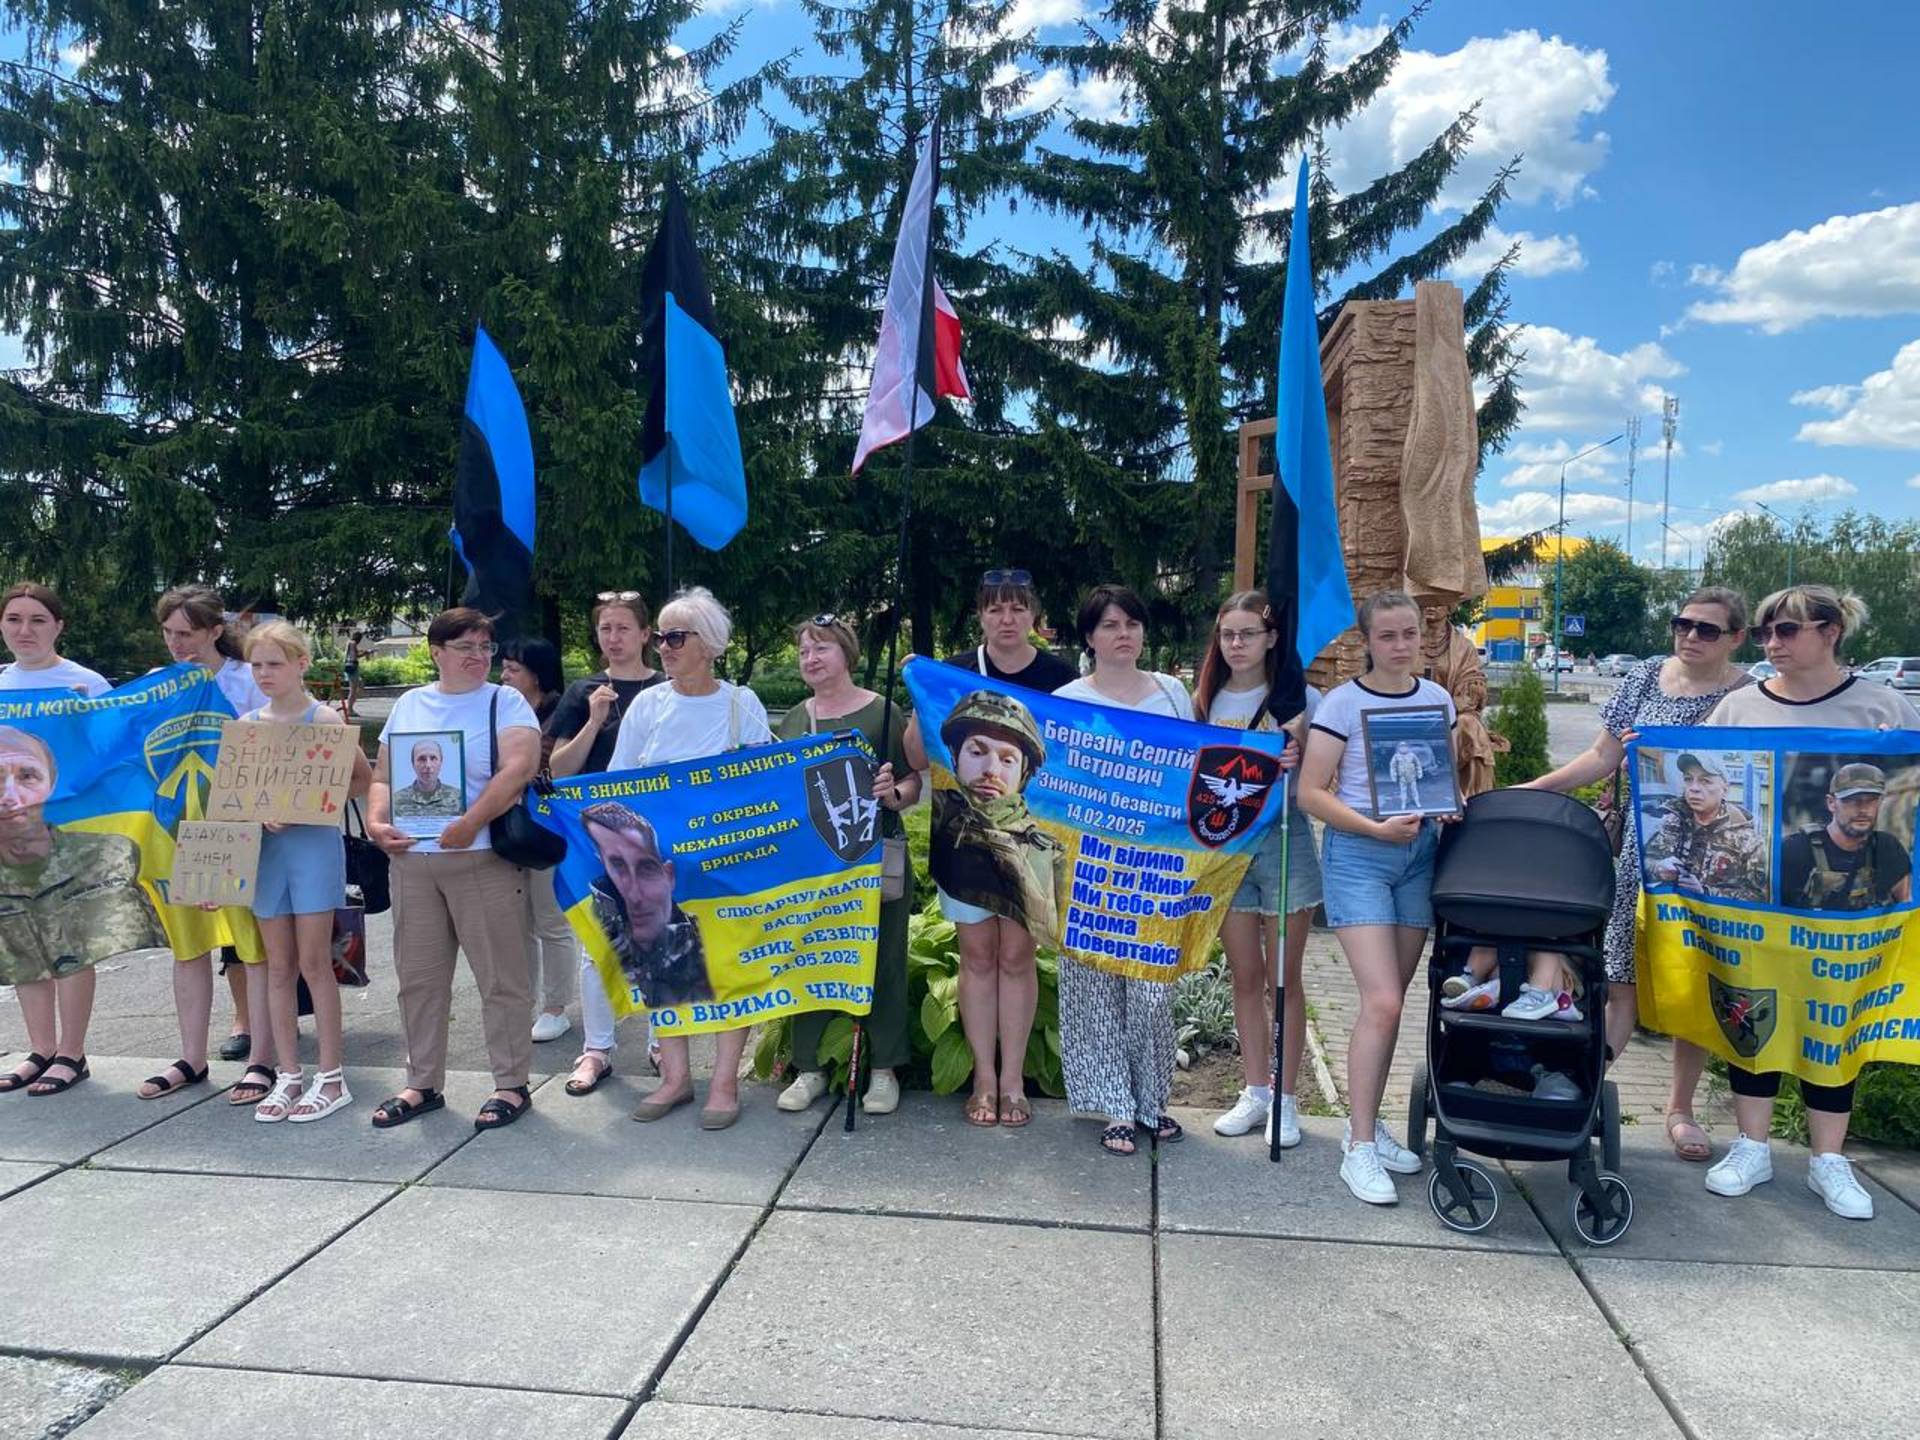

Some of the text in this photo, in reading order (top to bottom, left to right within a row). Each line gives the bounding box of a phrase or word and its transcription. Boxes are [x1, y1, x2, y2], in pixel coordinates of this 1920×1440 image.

[285, 725, 345, 744] ХОЧУ
[1044, 719, 1198, 770] Березін Сергій
[589, 773, 671, 799] ЗНИКЛИЙ
[689, 769, 713, 786] НЕ
[717, 752, 798, 780] ЗНАЧИТЬ
[1066, 747, 1164, 788] Петрович
[1038, 771, 1182, 820] Зниклий безвісти
[688, 800, 780, 829] 67 ОКРЕМА
[1065, 802, 1147, 836] 14.02.2025
[672, 818, 800, 854] МЕХАНІЗОВАНА
[701, 843, 779, 872] БРИГАДА
[1079, 834, 1185, 873] Ми віримо
[1074, 860, 1109, 884] що
[1112, 870, 1137, 889] ти
[1072, 881, 1103, 907] Ми
[1106, 892, 1155, 916] тебе
[1067, 906, 1138, 936] вдома
[739, 940, 796, 964] ЗНИК
[770, 949, 860, 978] 21.05.2025
[693, 988, 798, 1023] ВІРИМО,
[1806, 999, 1848, 1028] 110
[1803, 1036, 1843, 1066] МИ
